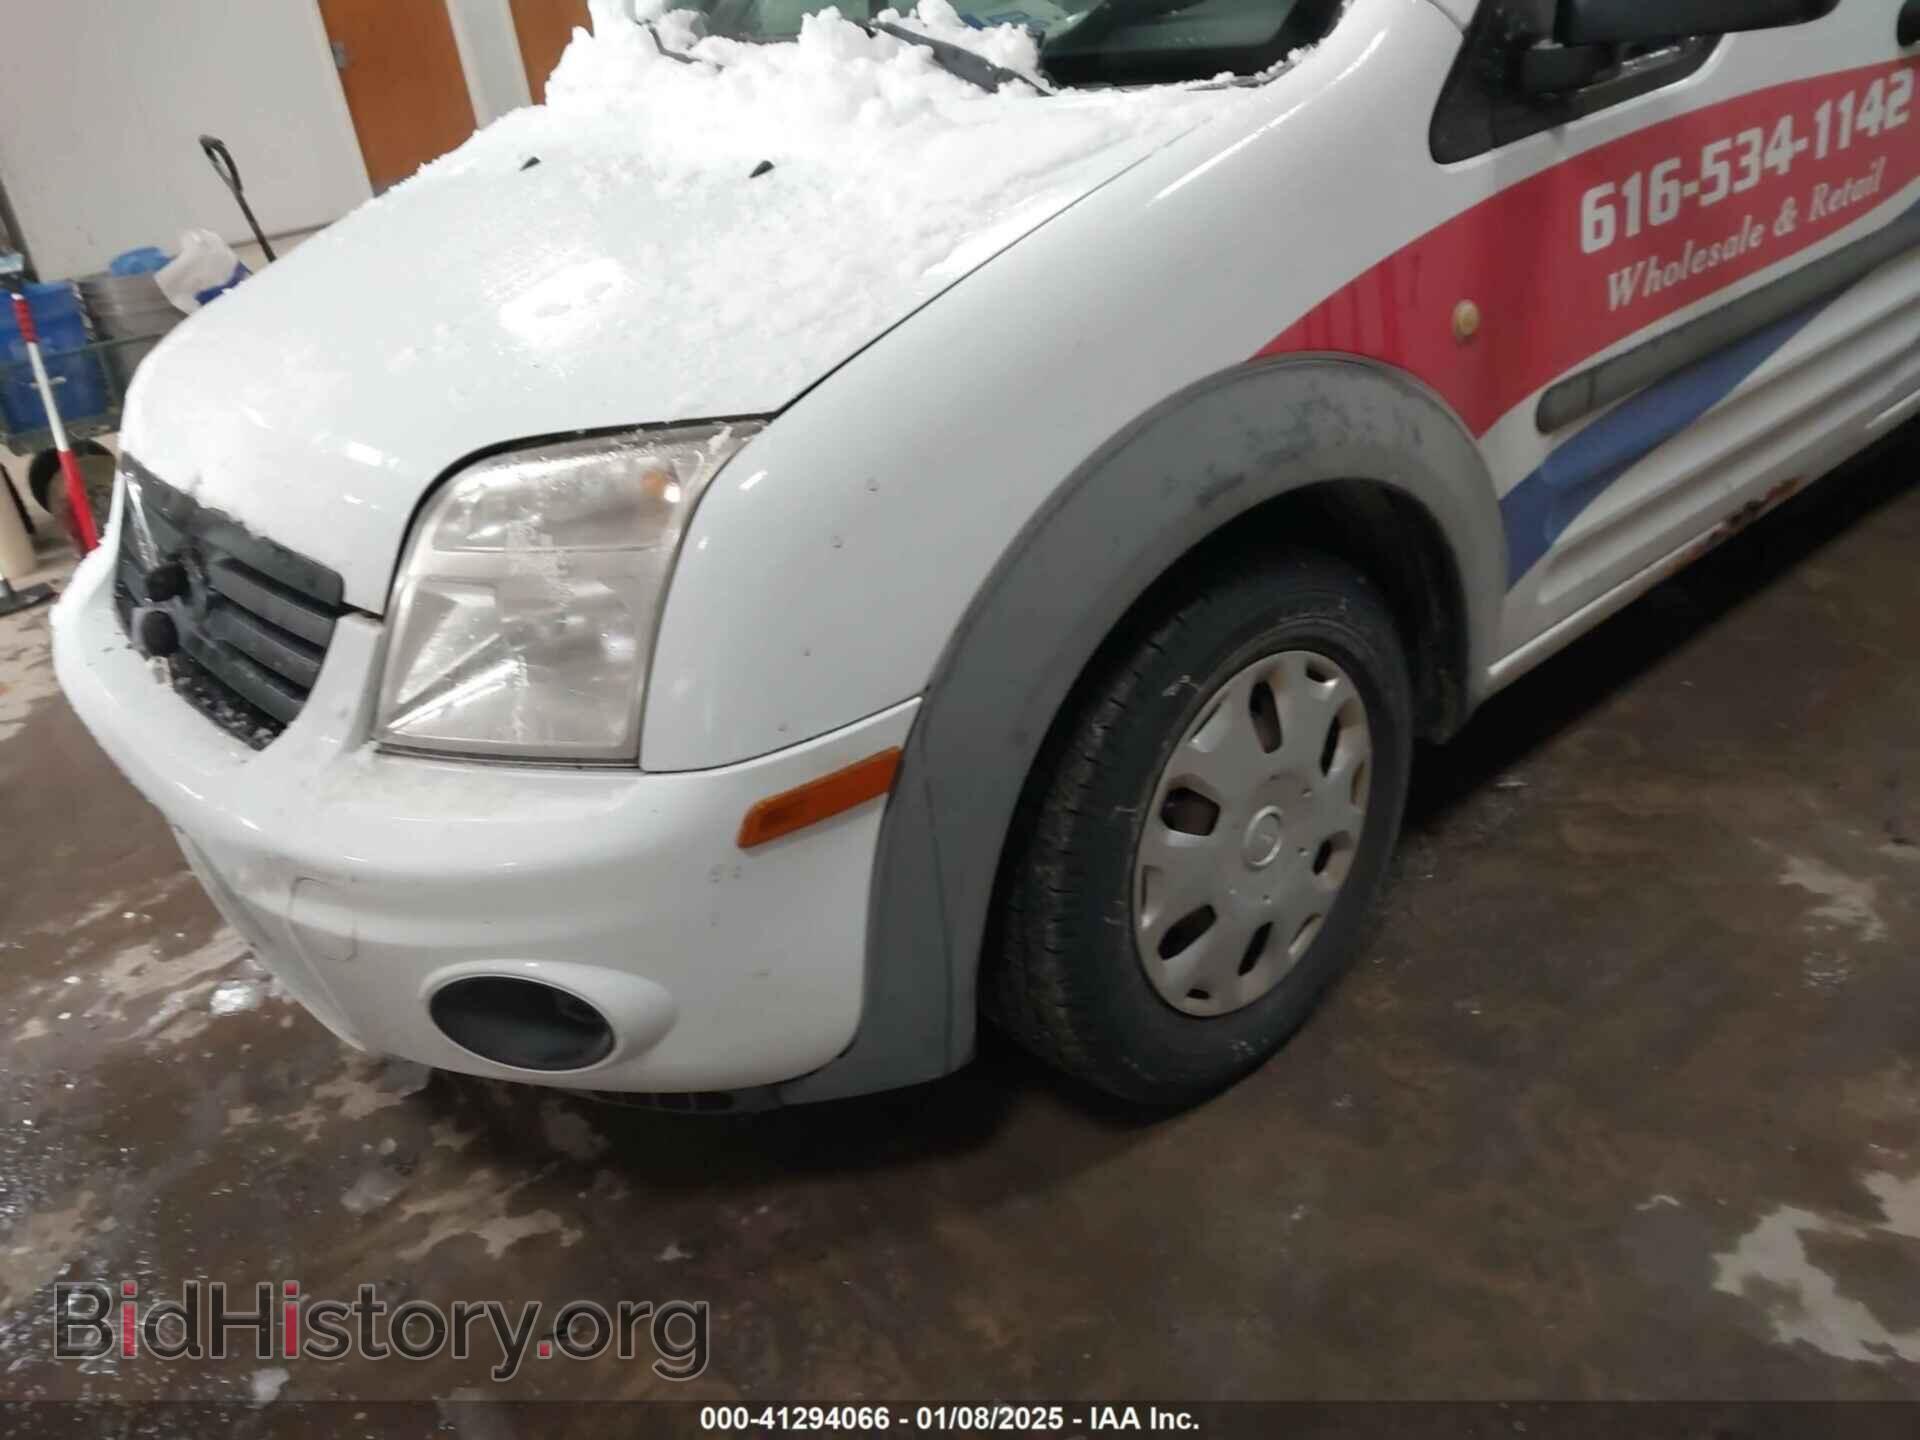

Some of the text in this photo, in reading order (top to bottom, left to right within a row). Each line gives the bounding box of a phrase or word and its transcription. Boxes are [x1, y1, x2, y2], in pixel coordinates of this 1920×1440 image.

[1580, 67, 1914, 255] 616-534-1142
[1607, 156, 1888, 312] Wholesale & Retail
